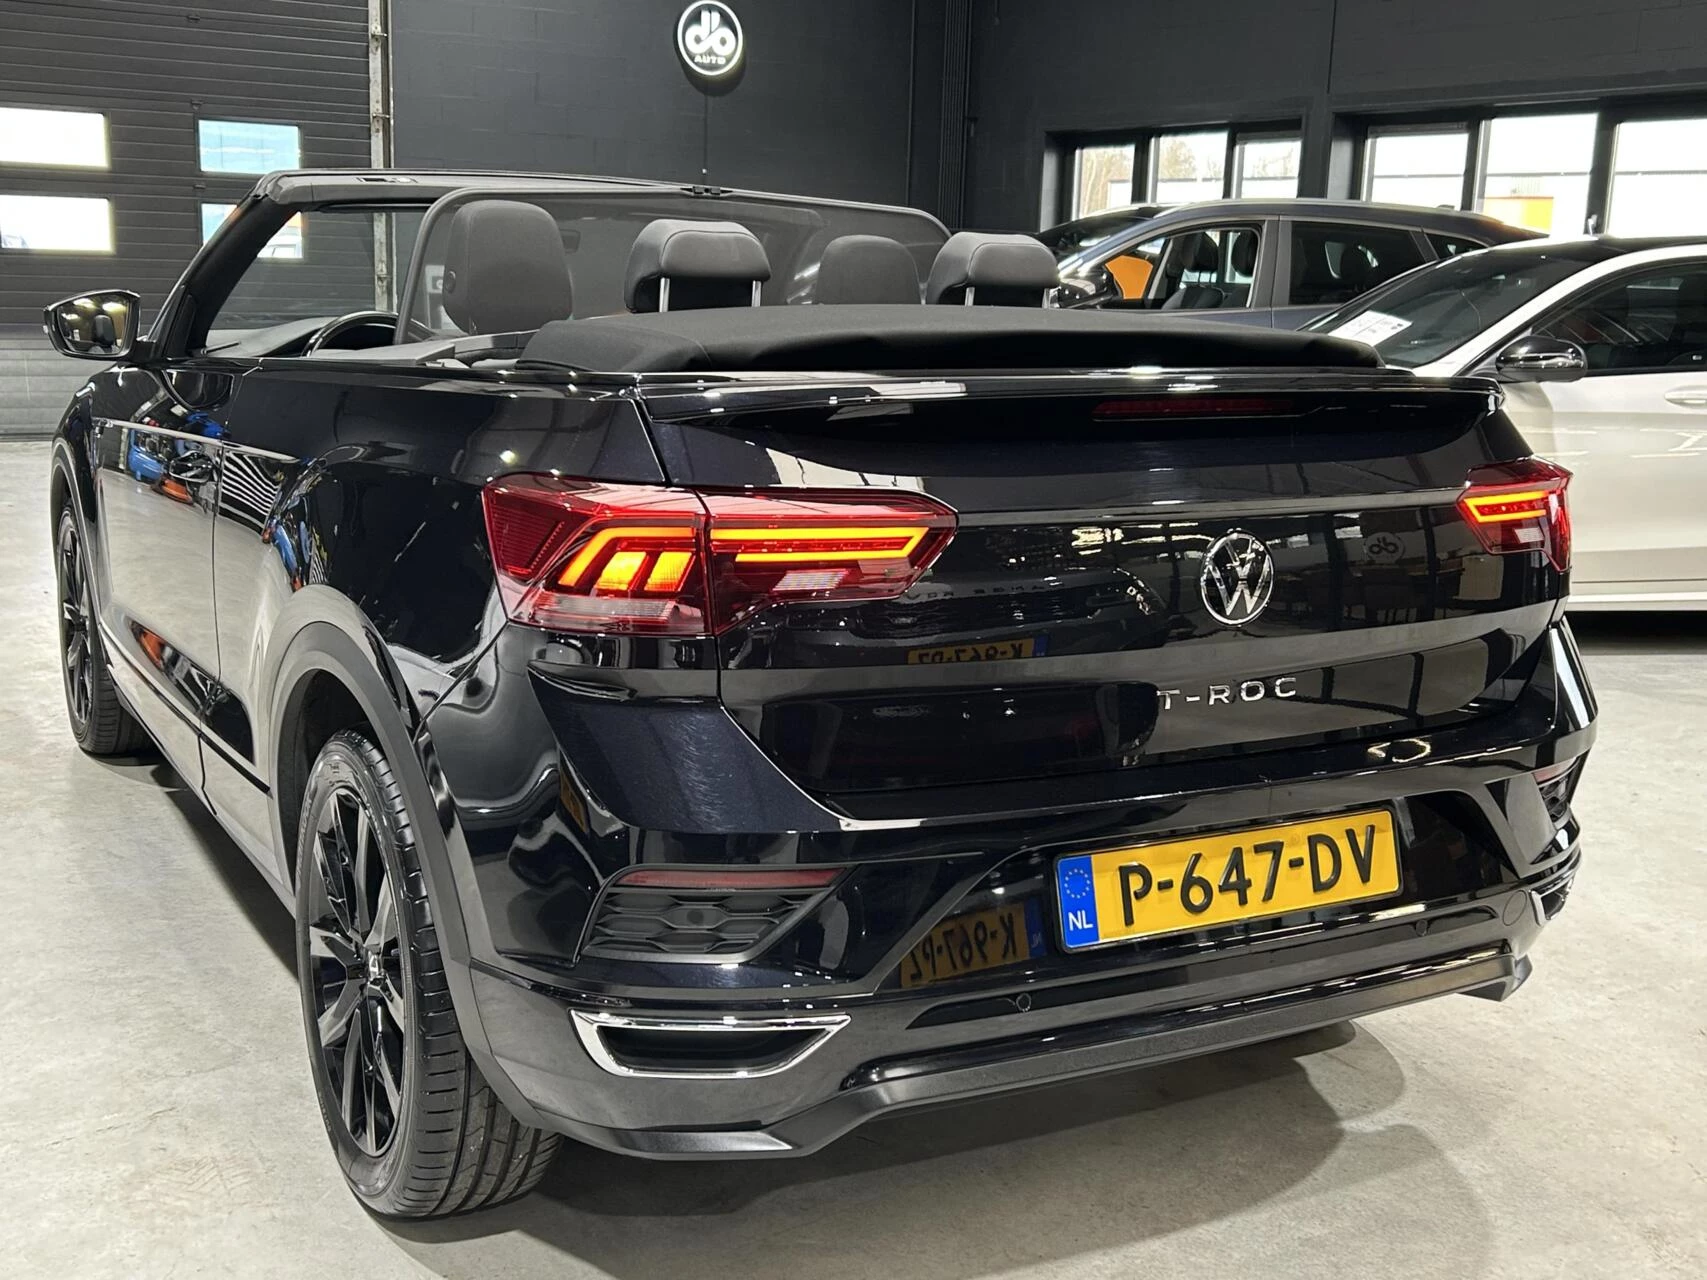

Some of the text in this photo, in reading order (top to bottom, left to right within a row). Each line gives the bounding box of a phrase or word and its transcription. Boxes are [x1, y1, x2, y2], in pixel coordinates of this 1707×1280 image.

[694, 55, 726, 65] AUTO
[1157, 677, 1296, 710] T-ROC
[1118, 824, 1376, 927] P-647-DV
[1068, 909, 1093, 931] NL
